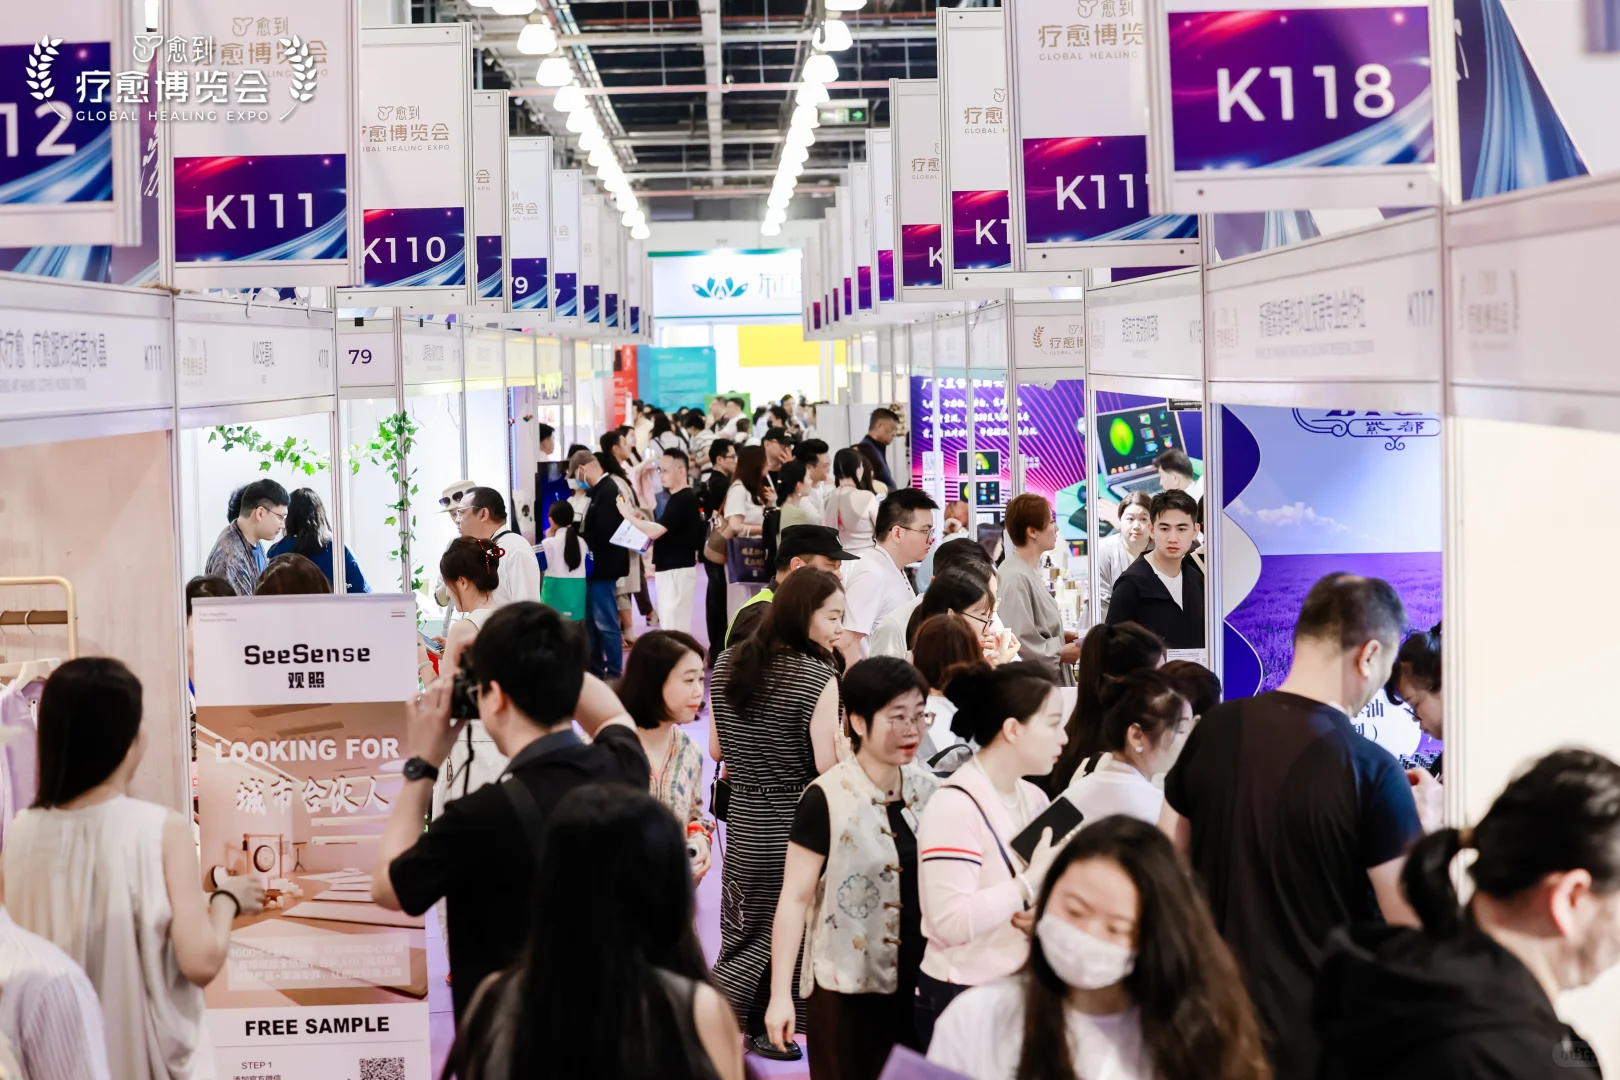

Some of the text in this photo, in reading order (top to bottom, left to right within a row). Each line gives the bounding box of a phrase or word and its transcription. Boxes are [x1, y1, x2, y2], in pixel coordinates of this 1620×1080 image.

[256, 17, 289, 36] 愈到
[1038, 51, 1139, 61] GLOBAL HEALING
[1216, 62, 1397, 123] K118
[395, 105, 421, 121] 愈到
[964, 106, 1003, 125] 疗愈
[1055, 173, 1149, 211] K11
[205, 192, 314, 231] K111
[363, 236, 447, 265] K110
[348, 348, 372, 366] 79
[244, 643, 371, 666] SeeSense
[288, 671, 326, 689] 观照
[215, 735, 401, 763] LOOKING FOR
[235, 774, 390, 816] 城市合伙人
[244, 1016, 391, 1037] FREE SAMPLE
[241, 1061, 266, 1070] STEP
